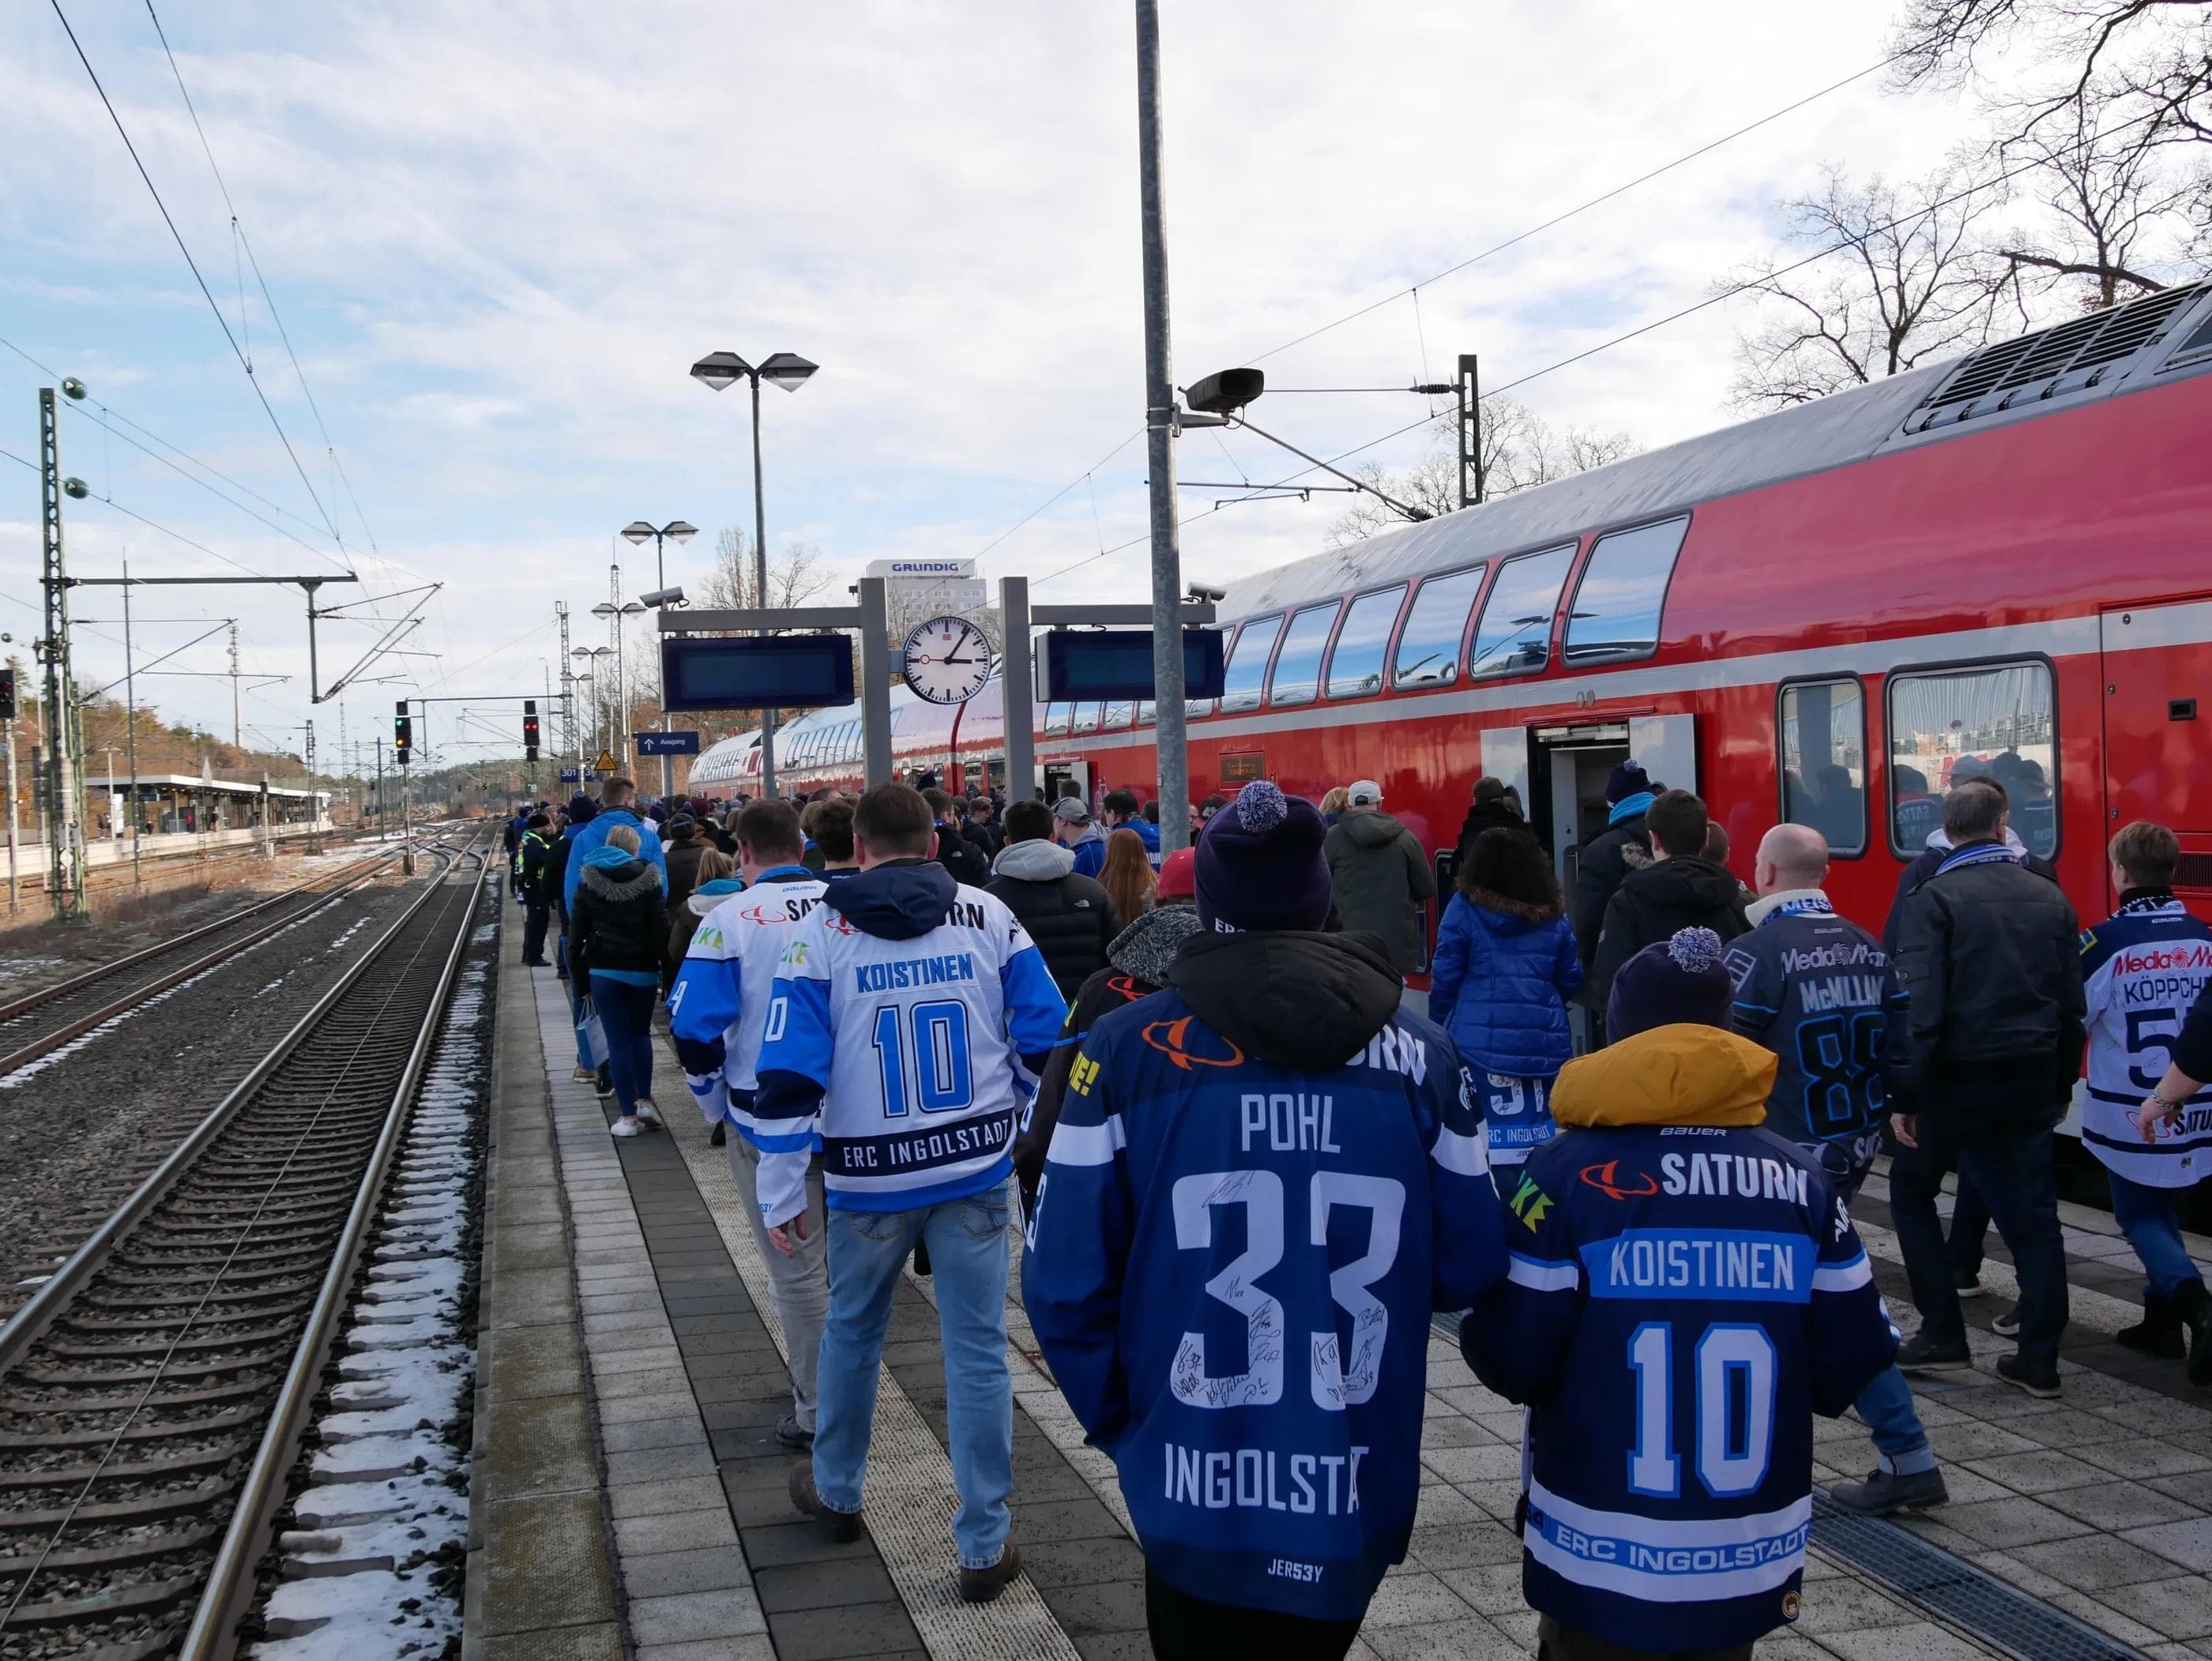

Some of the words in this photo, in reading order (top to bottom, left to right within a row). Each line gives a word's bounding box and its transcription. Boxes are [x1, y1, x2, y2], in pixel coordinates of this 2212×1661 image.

[892, 563, 959, 572] GRUNDIG
[562, 768, 576, 777] 301
[946, 902, 985, 930] RN
[856, 953, 973, 993] KOISTINEN
[2112, 950, 2172, 979] Media
[2124, 975, 2209, 1004] KÖPPCH
[871, 998, 974, 1119] 10
[843, 1145, 878, 1167] ERC
[890, 1118, 1010, 1165] INGOLSTADT
[1241, 1093, 1341, 1154] POHL
[2174, 1108, 2212, 1137] SATU
[1660, 1152, 1809, 1207] SATURN
[1609, 1240, 1795, 1291] KOISTINEN
[1170, 1169, 1407, 1411] 33
[1627, 1321, 1778, 1498] 10
[1556, 1524, 1616, 1561] ERC
[1629, 1525, 1809, 1572] INGOLSTADT
